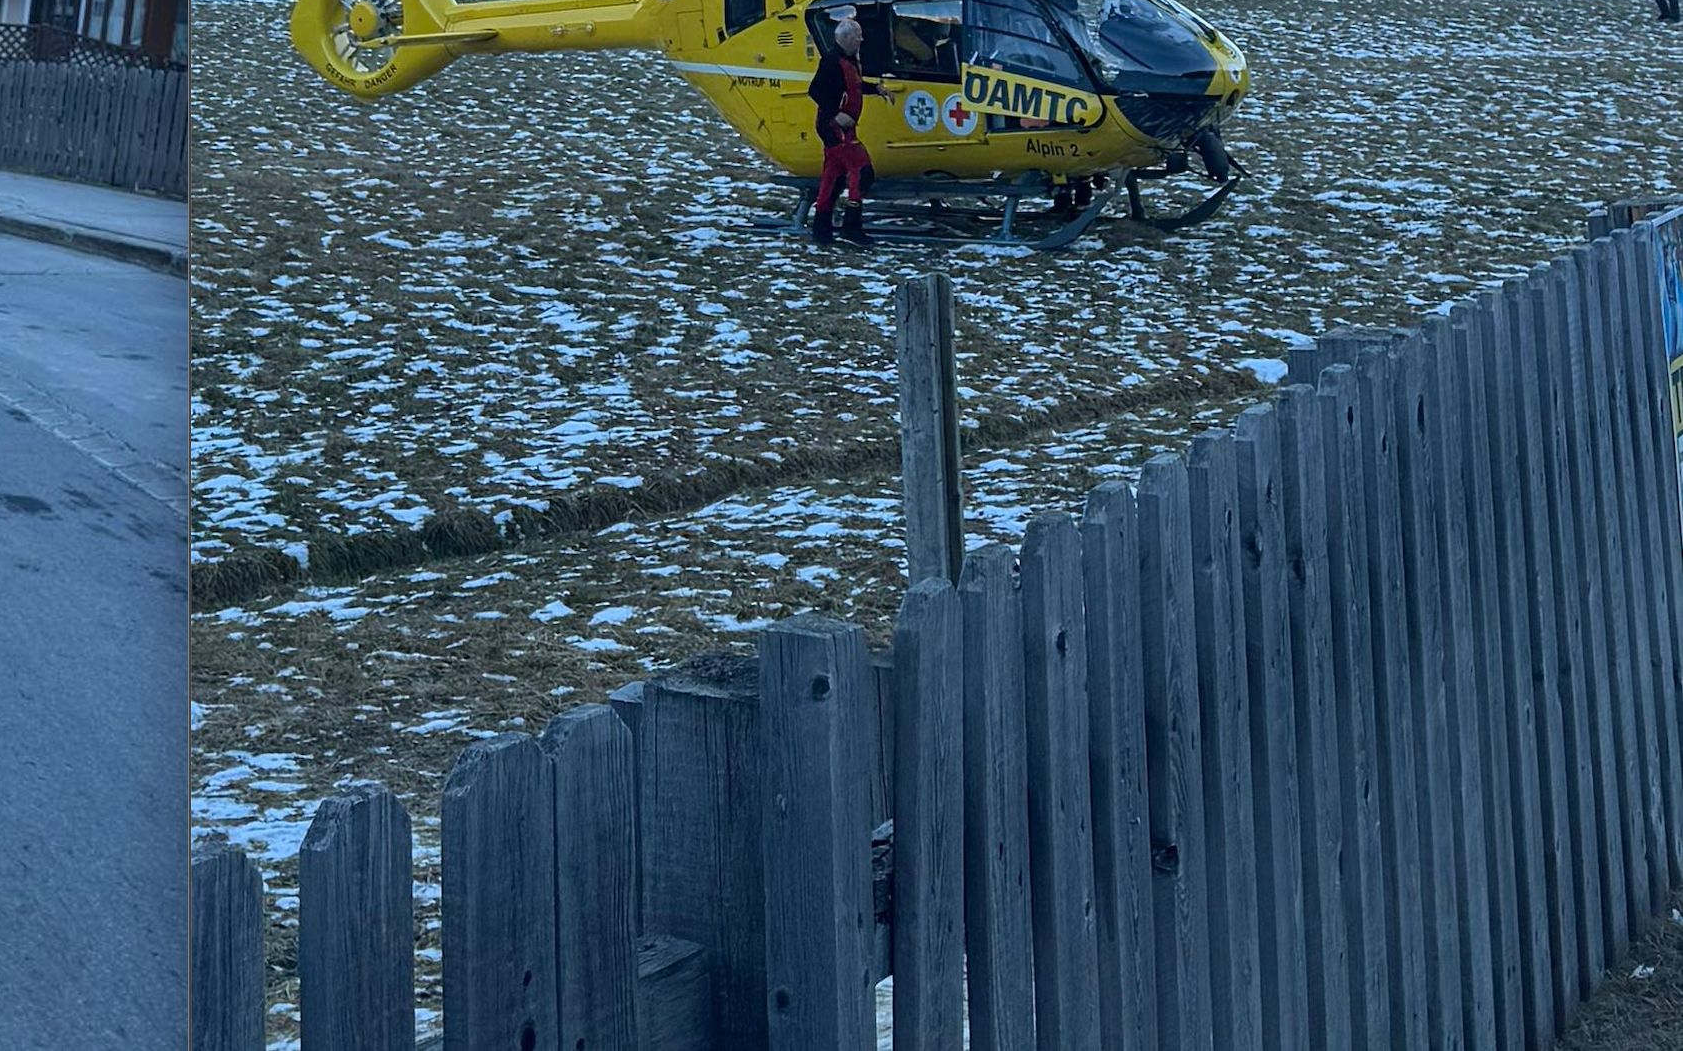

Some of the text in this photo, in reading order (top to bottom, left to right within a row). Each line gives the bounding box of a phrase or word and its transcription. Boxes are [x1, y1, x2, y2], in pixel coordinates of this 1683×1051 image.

[364, 63, 398, 89] DANGER
[737, 75, 781, 88] NOTRUF 144
[964, 71, 1088, 126] ÖAMTC
[1026, 138, 1081, 158] Alpin 2
